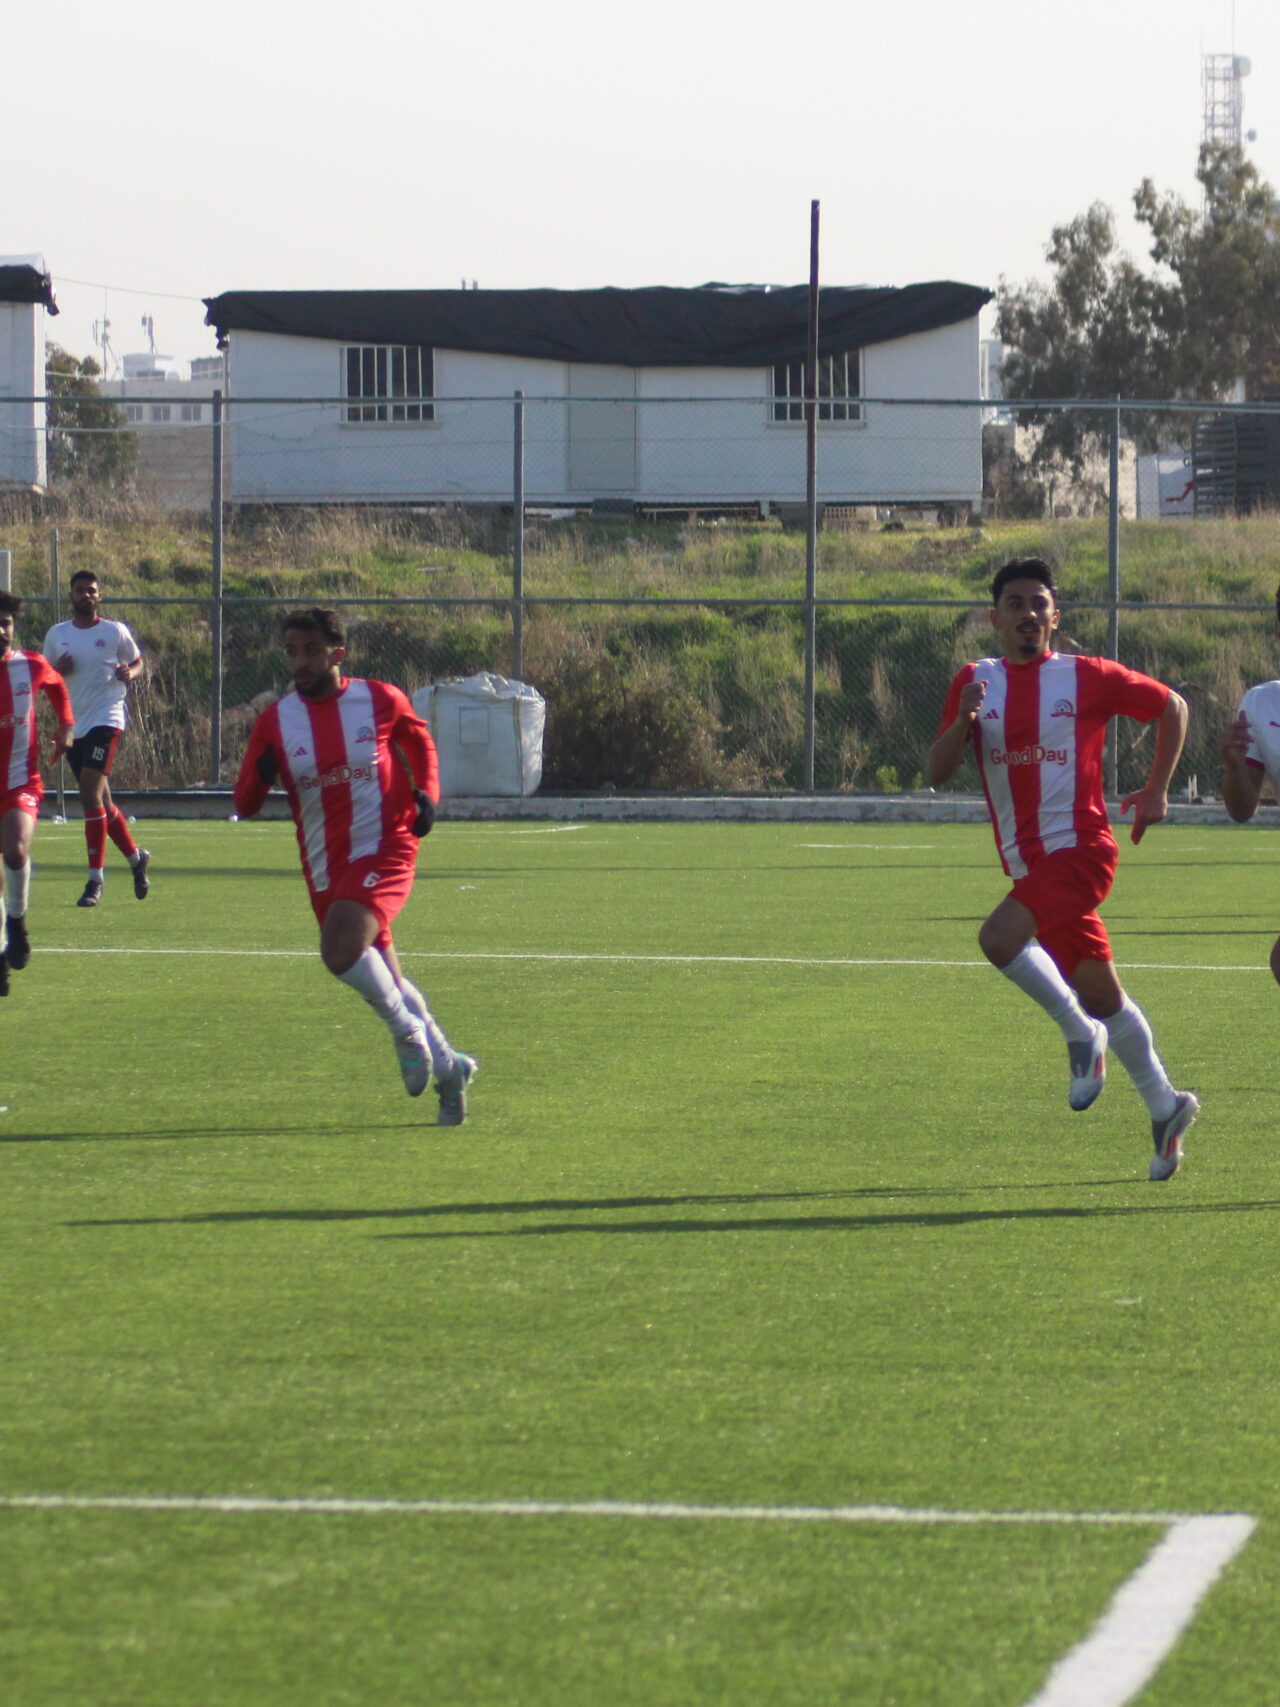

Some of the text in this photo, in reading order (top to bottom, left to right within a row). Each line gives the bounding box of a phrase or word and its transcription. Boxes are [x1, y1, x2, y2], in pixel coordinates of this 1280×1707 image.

[991, 746, 1067, 766] Good Day
[340, 765, 371, 783] Day
